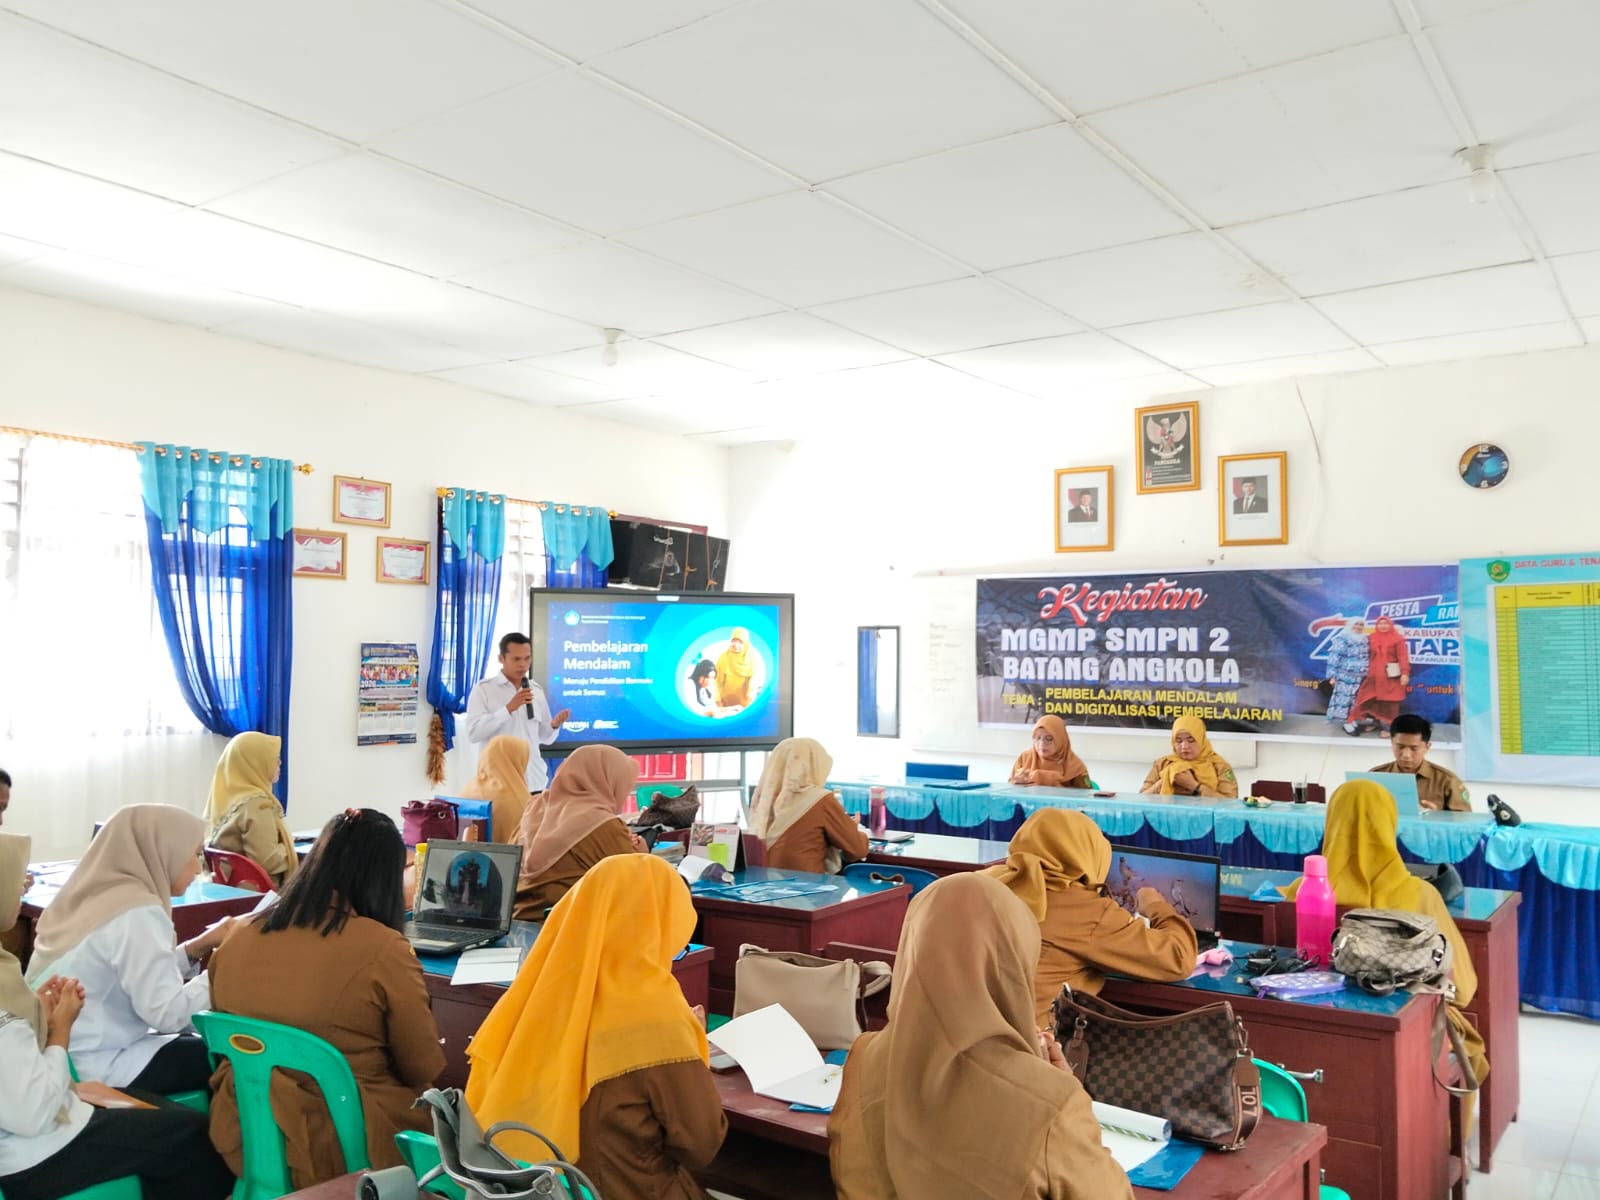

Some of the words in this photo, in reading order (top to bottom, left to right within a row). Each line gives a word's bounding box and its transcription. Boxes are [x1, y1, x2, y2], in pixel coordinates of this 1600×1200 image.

[1038, 578, 1208, 627] Kegiatan
[1381, 601, 1420, 618] PESTA
[565, 640, 648, 655] Pembelajaran
[1001, 627, 1096, 652] MGMP
[1105, 627, 1200, 652] SMPN
[1209, 627, 1230, 653] 2
[564, 657, 631, 670] Mendalam
[1003, 656, 1099, 682] BATANG
[1109, 656, 1240, 684] ANGKOLA
[1293, 677, 1321, 690] Sinerg
[1002, 693, 1035, 706] TEMA
[1045, 687, 1152, 702] PEMBELAJARAN
[1155, 690, 1237, 704] MENDALAM
[1045, 702, 1073, 714] DAN
[1075, 702, 1160, 717] DIGITALISASI
[1163, 705, 1282, 721] PEMBELAJARAN
